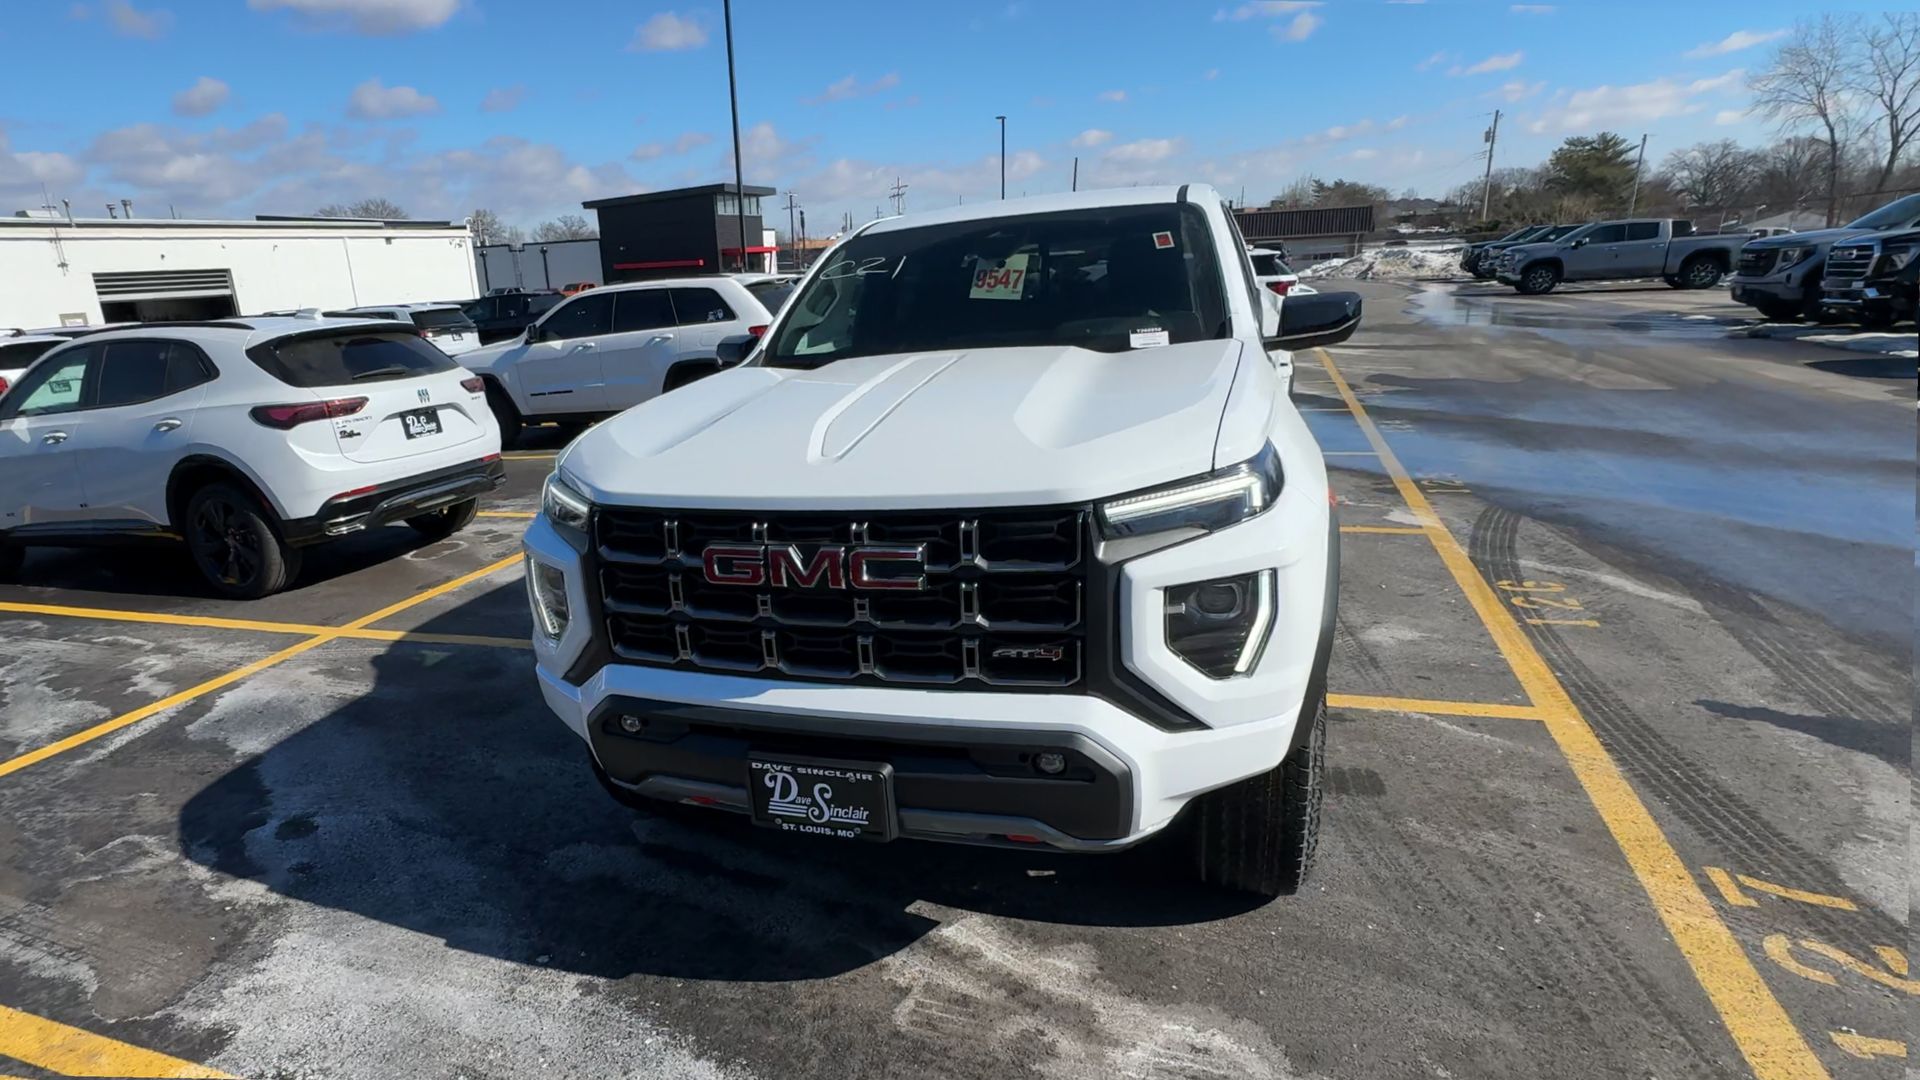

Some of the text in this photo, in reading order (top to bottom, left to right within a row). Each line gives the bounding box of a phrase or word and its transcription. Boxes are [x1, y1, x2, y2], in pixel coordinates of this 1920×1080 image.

[975, 268, 1024, 289] 9547
[701, 542, 928, 591] GMC
[751, 761, 873, 781] DAVE SINCLAIR
[763, 772, 870, 823] Dave Sinclair
[781, 823, 797, 831] ST.
[837, 829, 855, 838] MO
